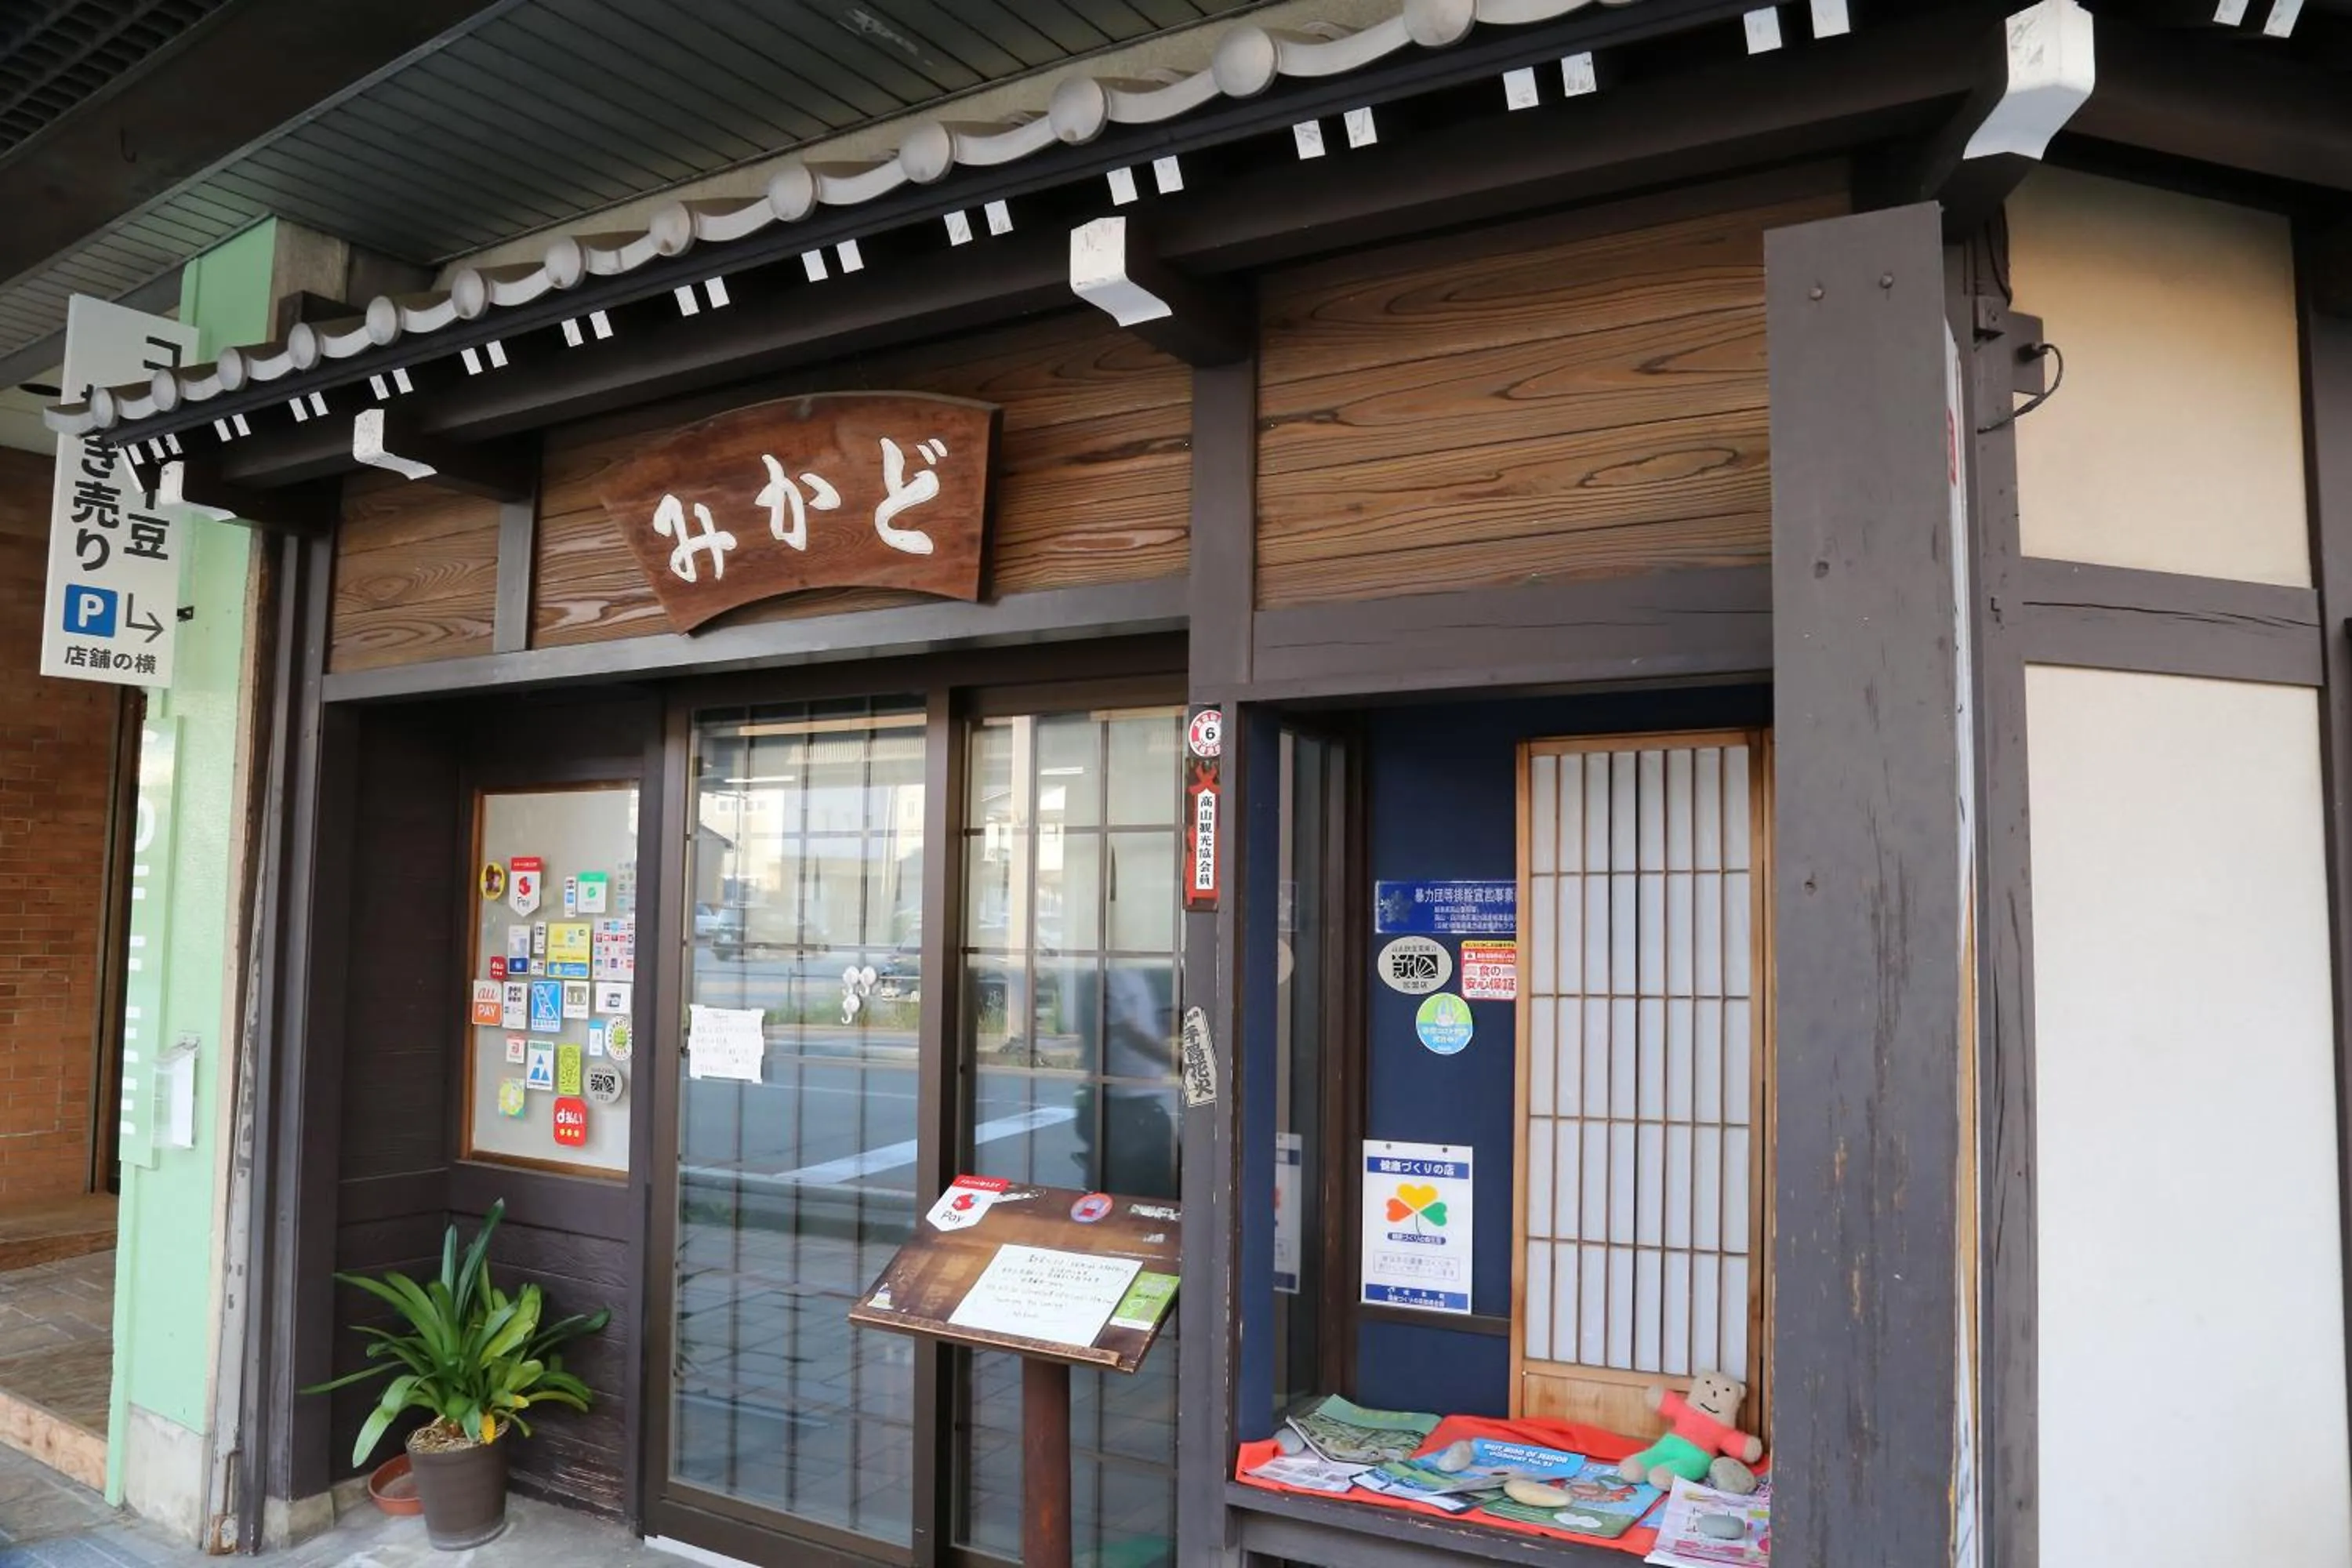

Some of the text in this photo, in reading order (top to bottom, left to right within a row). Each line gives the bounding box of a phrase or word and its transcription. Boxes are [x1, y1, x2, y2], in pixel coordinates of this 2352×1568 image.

[71, 384, 120, 571] き売り
[653, 437, 948, 583] みかど
[78, 593, 104, 628] P
[64, 645, 157, 674] 店舗の横
[1206, 727, 1215, 739] 6
[1199, 796, 1213, 886] 高山観光協会員
[478, 1004, 497, 1017] PAY
[1380, 1160, 1456, 1176] 健康づくりの店
[941, 1210, 964, 1223] Pay
